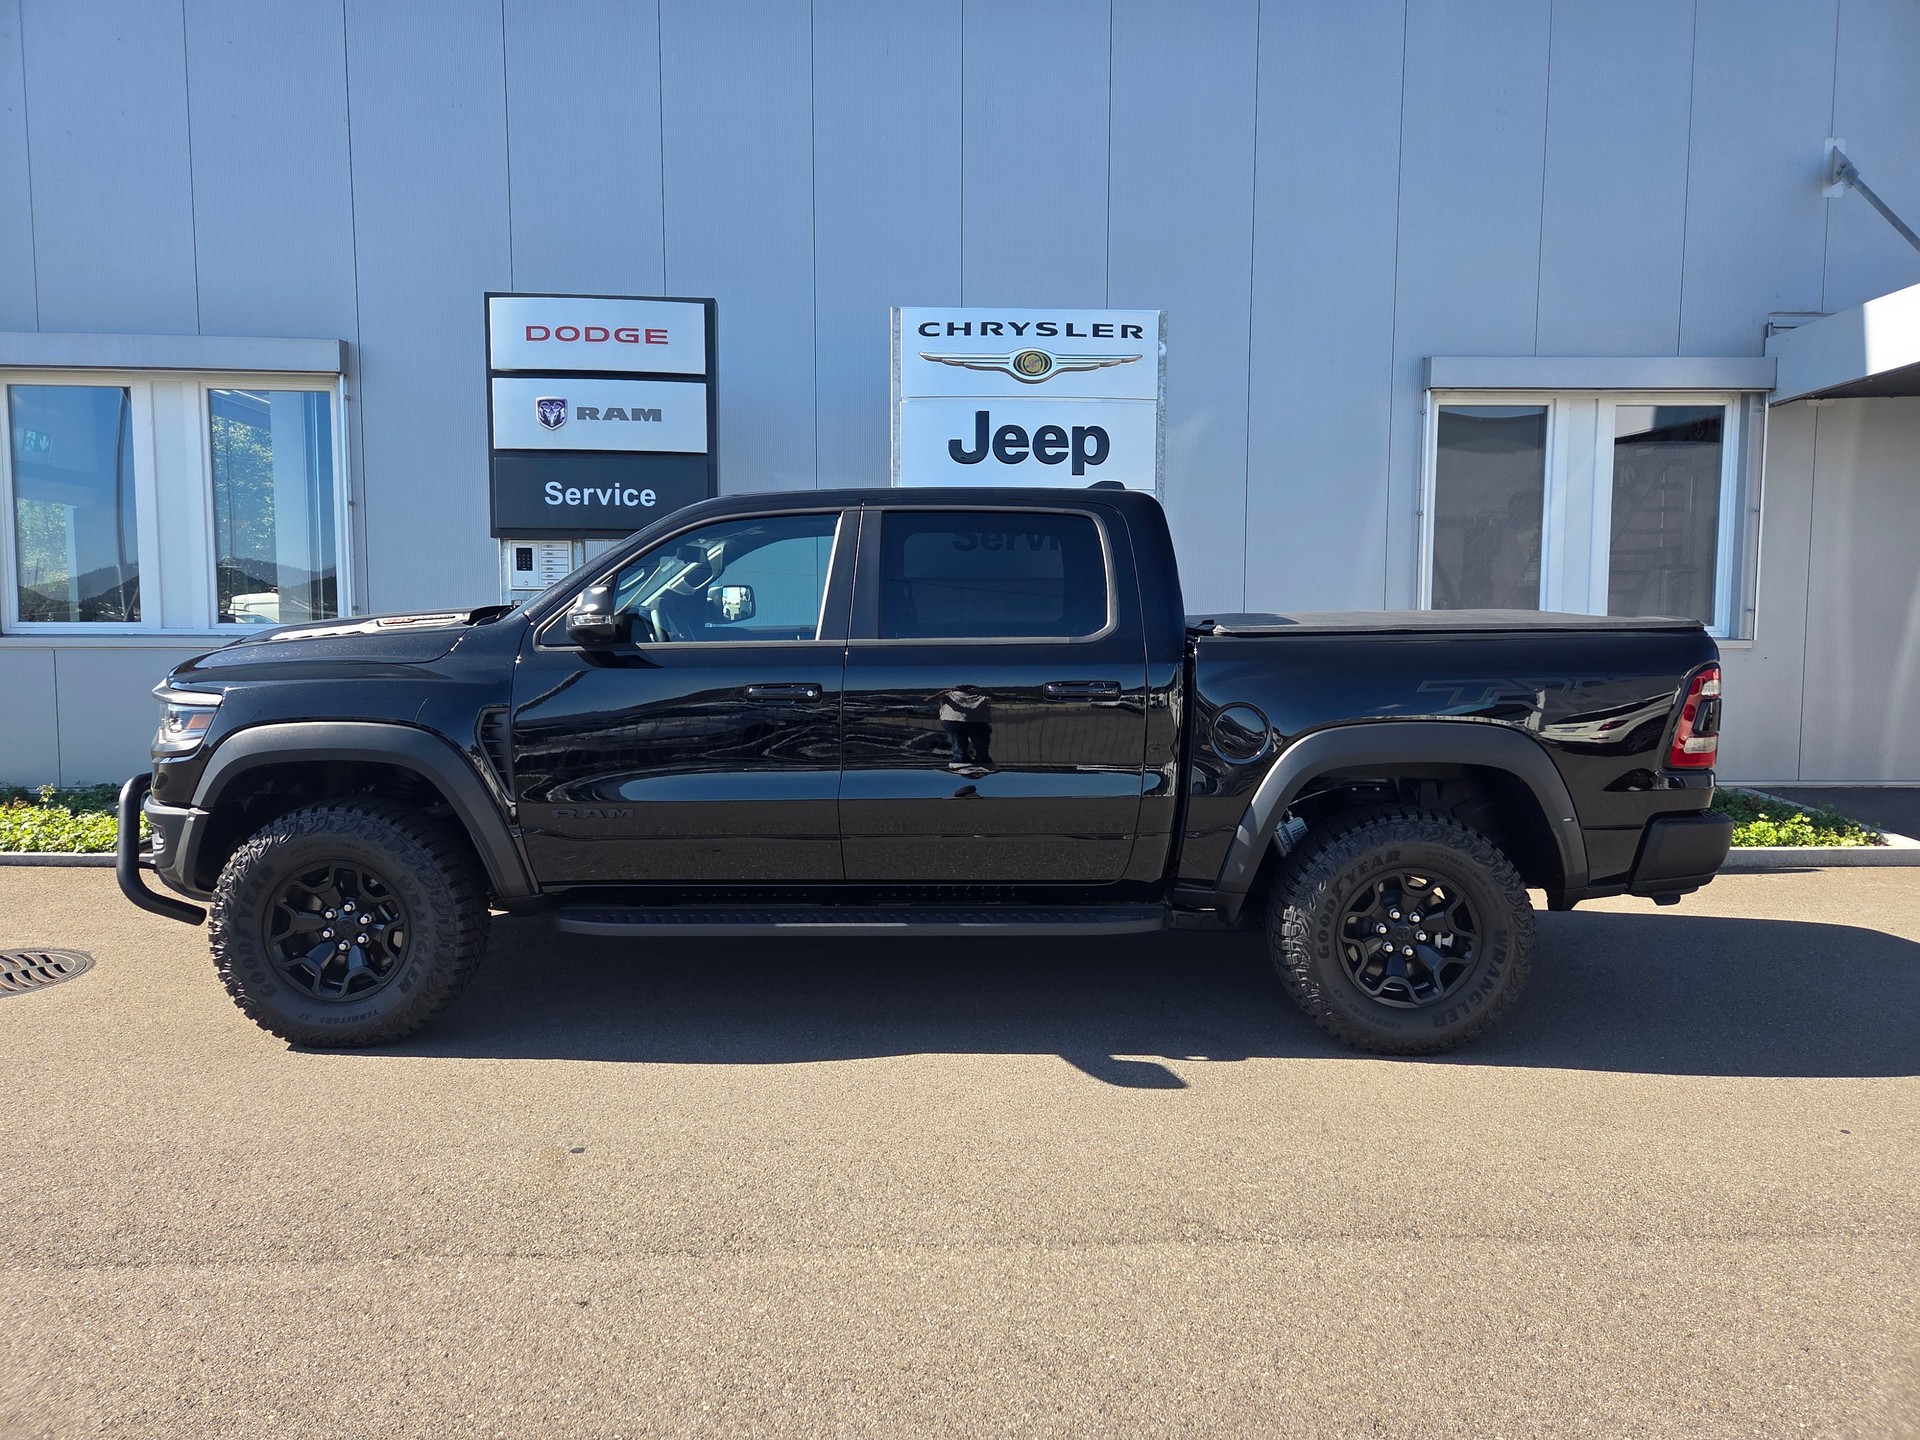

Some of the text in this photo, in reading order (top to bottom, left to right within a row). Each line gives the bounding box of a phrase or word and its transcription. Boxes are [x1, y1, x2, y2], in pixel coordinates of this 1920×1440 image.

[525, 325, 669, 345] DODGE
[918, 321, 1144, 339] CHRYSLER
[576, 406, 662, 422] RAM
[947, 410, 1110, 475] Jeep
[544, 481, 657, 507] Service
[551, 808, 635, 819] RAM
[1316, 848, 1401, 959] GOODYEAR
[1432, 929, 1509, 1028] WRANGLER
